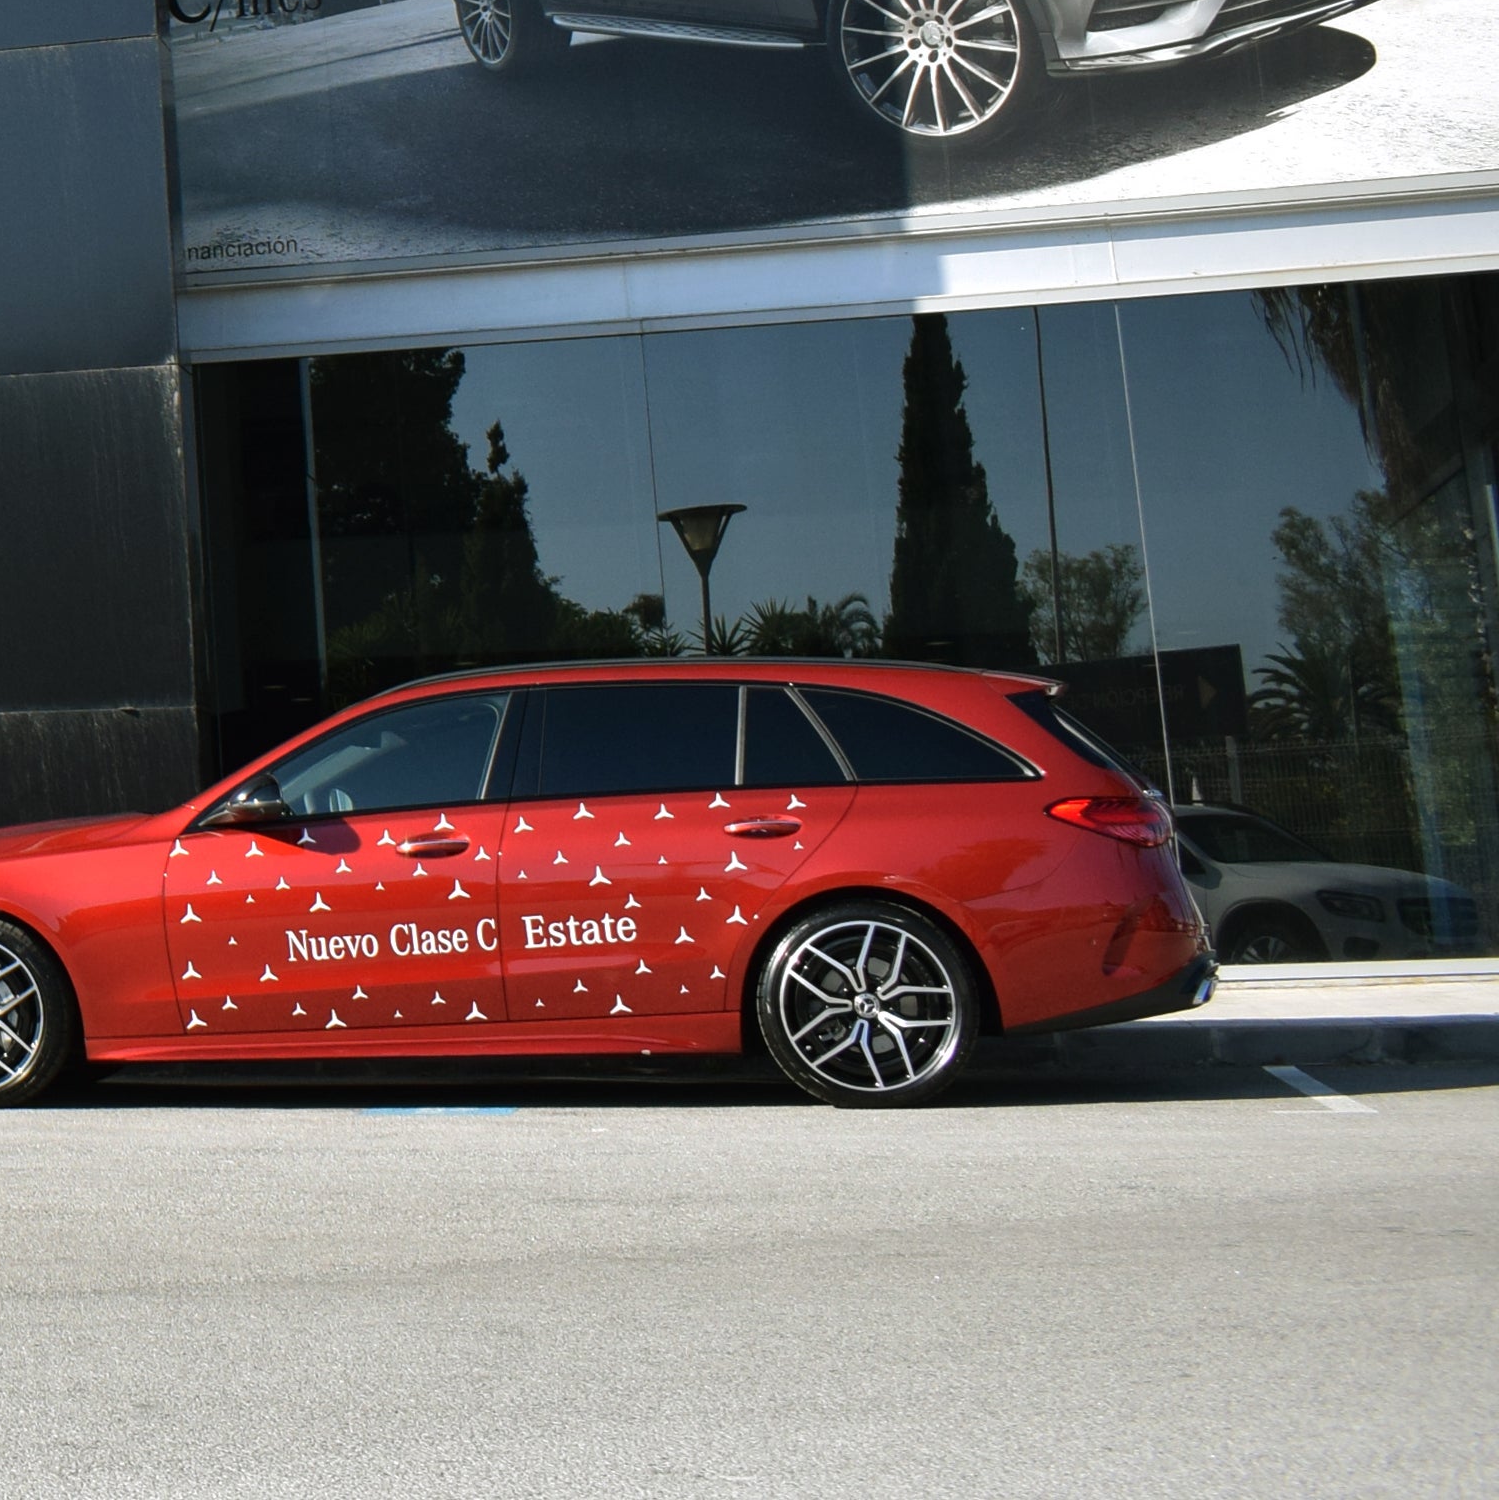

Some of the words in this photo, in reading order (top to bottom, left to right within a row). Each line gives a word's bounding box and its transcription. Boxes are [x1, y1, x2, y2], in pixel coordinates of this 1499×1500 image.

[287, 929, 379, 962] Nuevo
[390, 923, 469, 956] Clase
[477, 918, 498, 952] C
[522, 913, 637, 949] Estate
